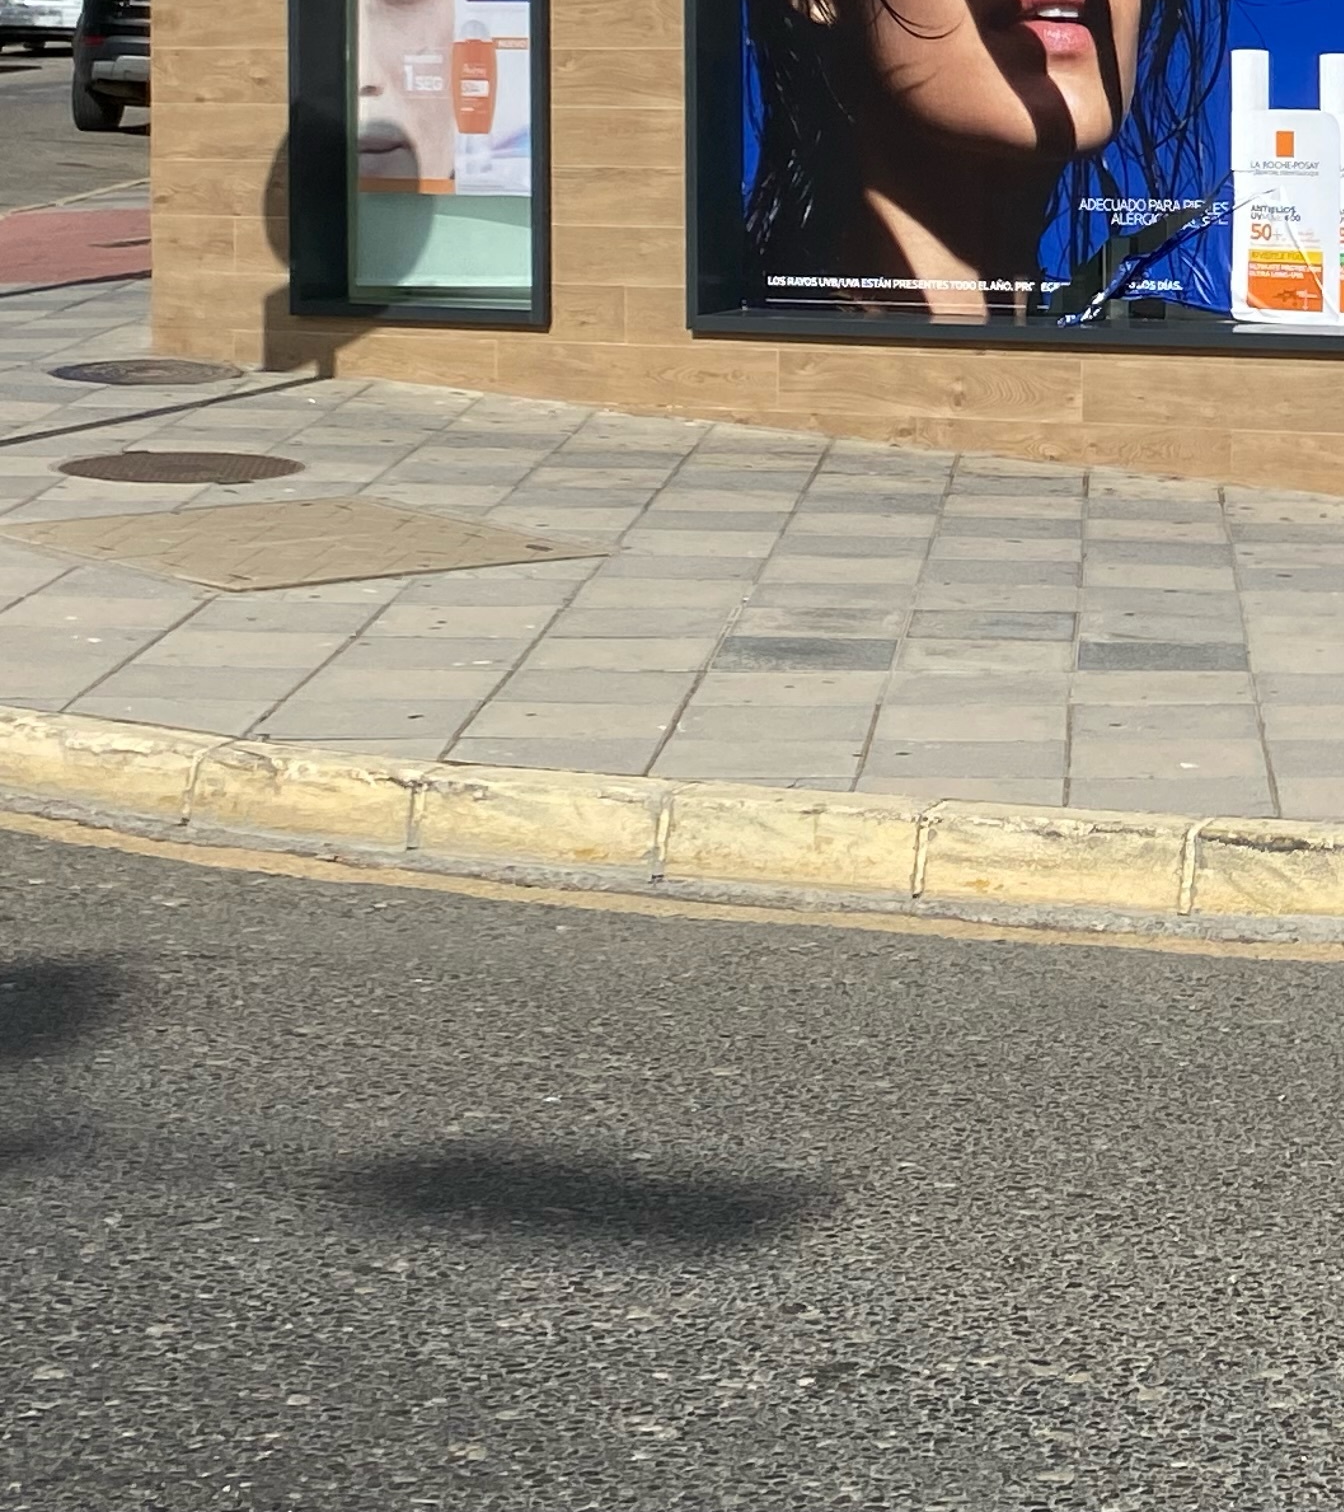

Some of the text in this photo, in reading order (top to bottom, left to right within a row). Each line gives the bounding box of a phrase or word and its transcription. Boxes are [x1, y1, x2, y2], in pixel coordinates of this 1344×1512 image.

[1079, 198, 1146, 212] ADECUADO
[1149, 199, 1181, 212] PARA
[767, 276, 786, 287] LOS
[787, 276, 818, 287] RAYOS
[818, 278, 860, 289] UVB/UVA
[861, 276, 891, 289] ESTÁN
[892, 279, 948, 290] PRESENTES
[950, 280, 976, 290] TODO
[978, 281, 989, 291] EL
